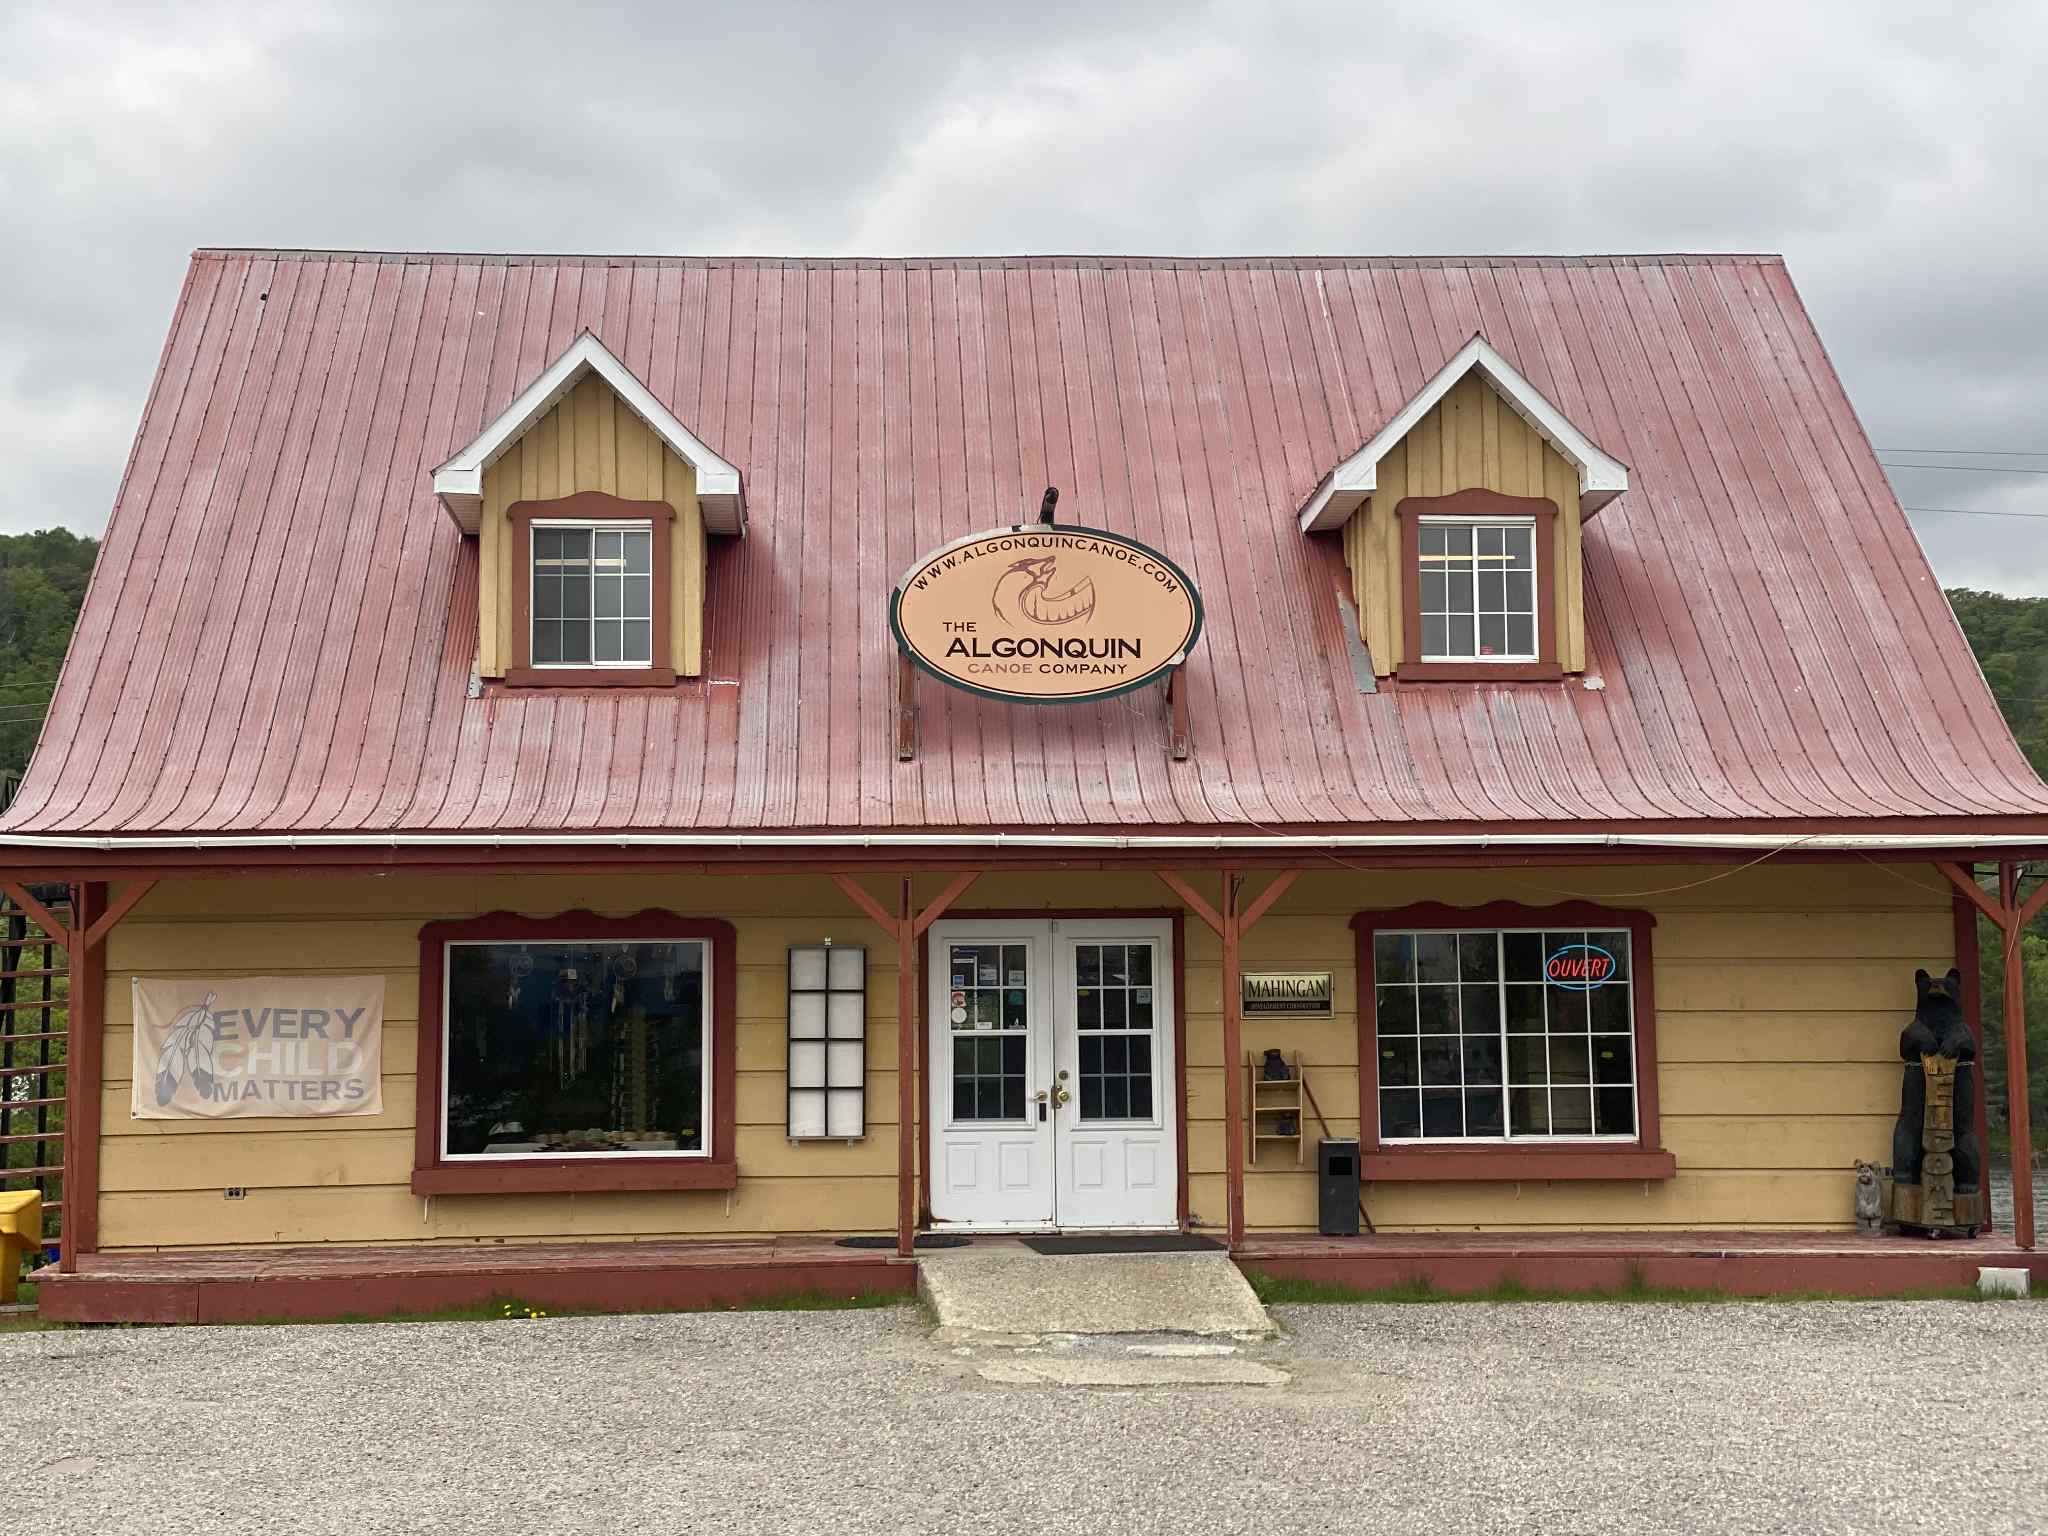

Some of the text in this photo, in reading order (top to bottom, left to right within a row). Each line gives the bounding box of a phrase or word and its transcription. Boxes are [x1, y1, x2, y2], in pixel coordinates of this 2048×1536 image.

[914, 536, 1177, 593] WWW.ALGONQUINCANOE.COM
[943, 622, 977, 632] THE
[946, 637, 1141, 659] ALGONQUIN
[968, 663, 1127, 674] CANOE COMPANY
[1549, 958, 1609, 977] OUVERT
[1248, 980, 1326, 998] MAHINGAN
[213, 1008, 366, 1041] EVERY
[215, 1041, 362, 1075] CHILD
[214, 1079, 365, 1102] MATTERS
